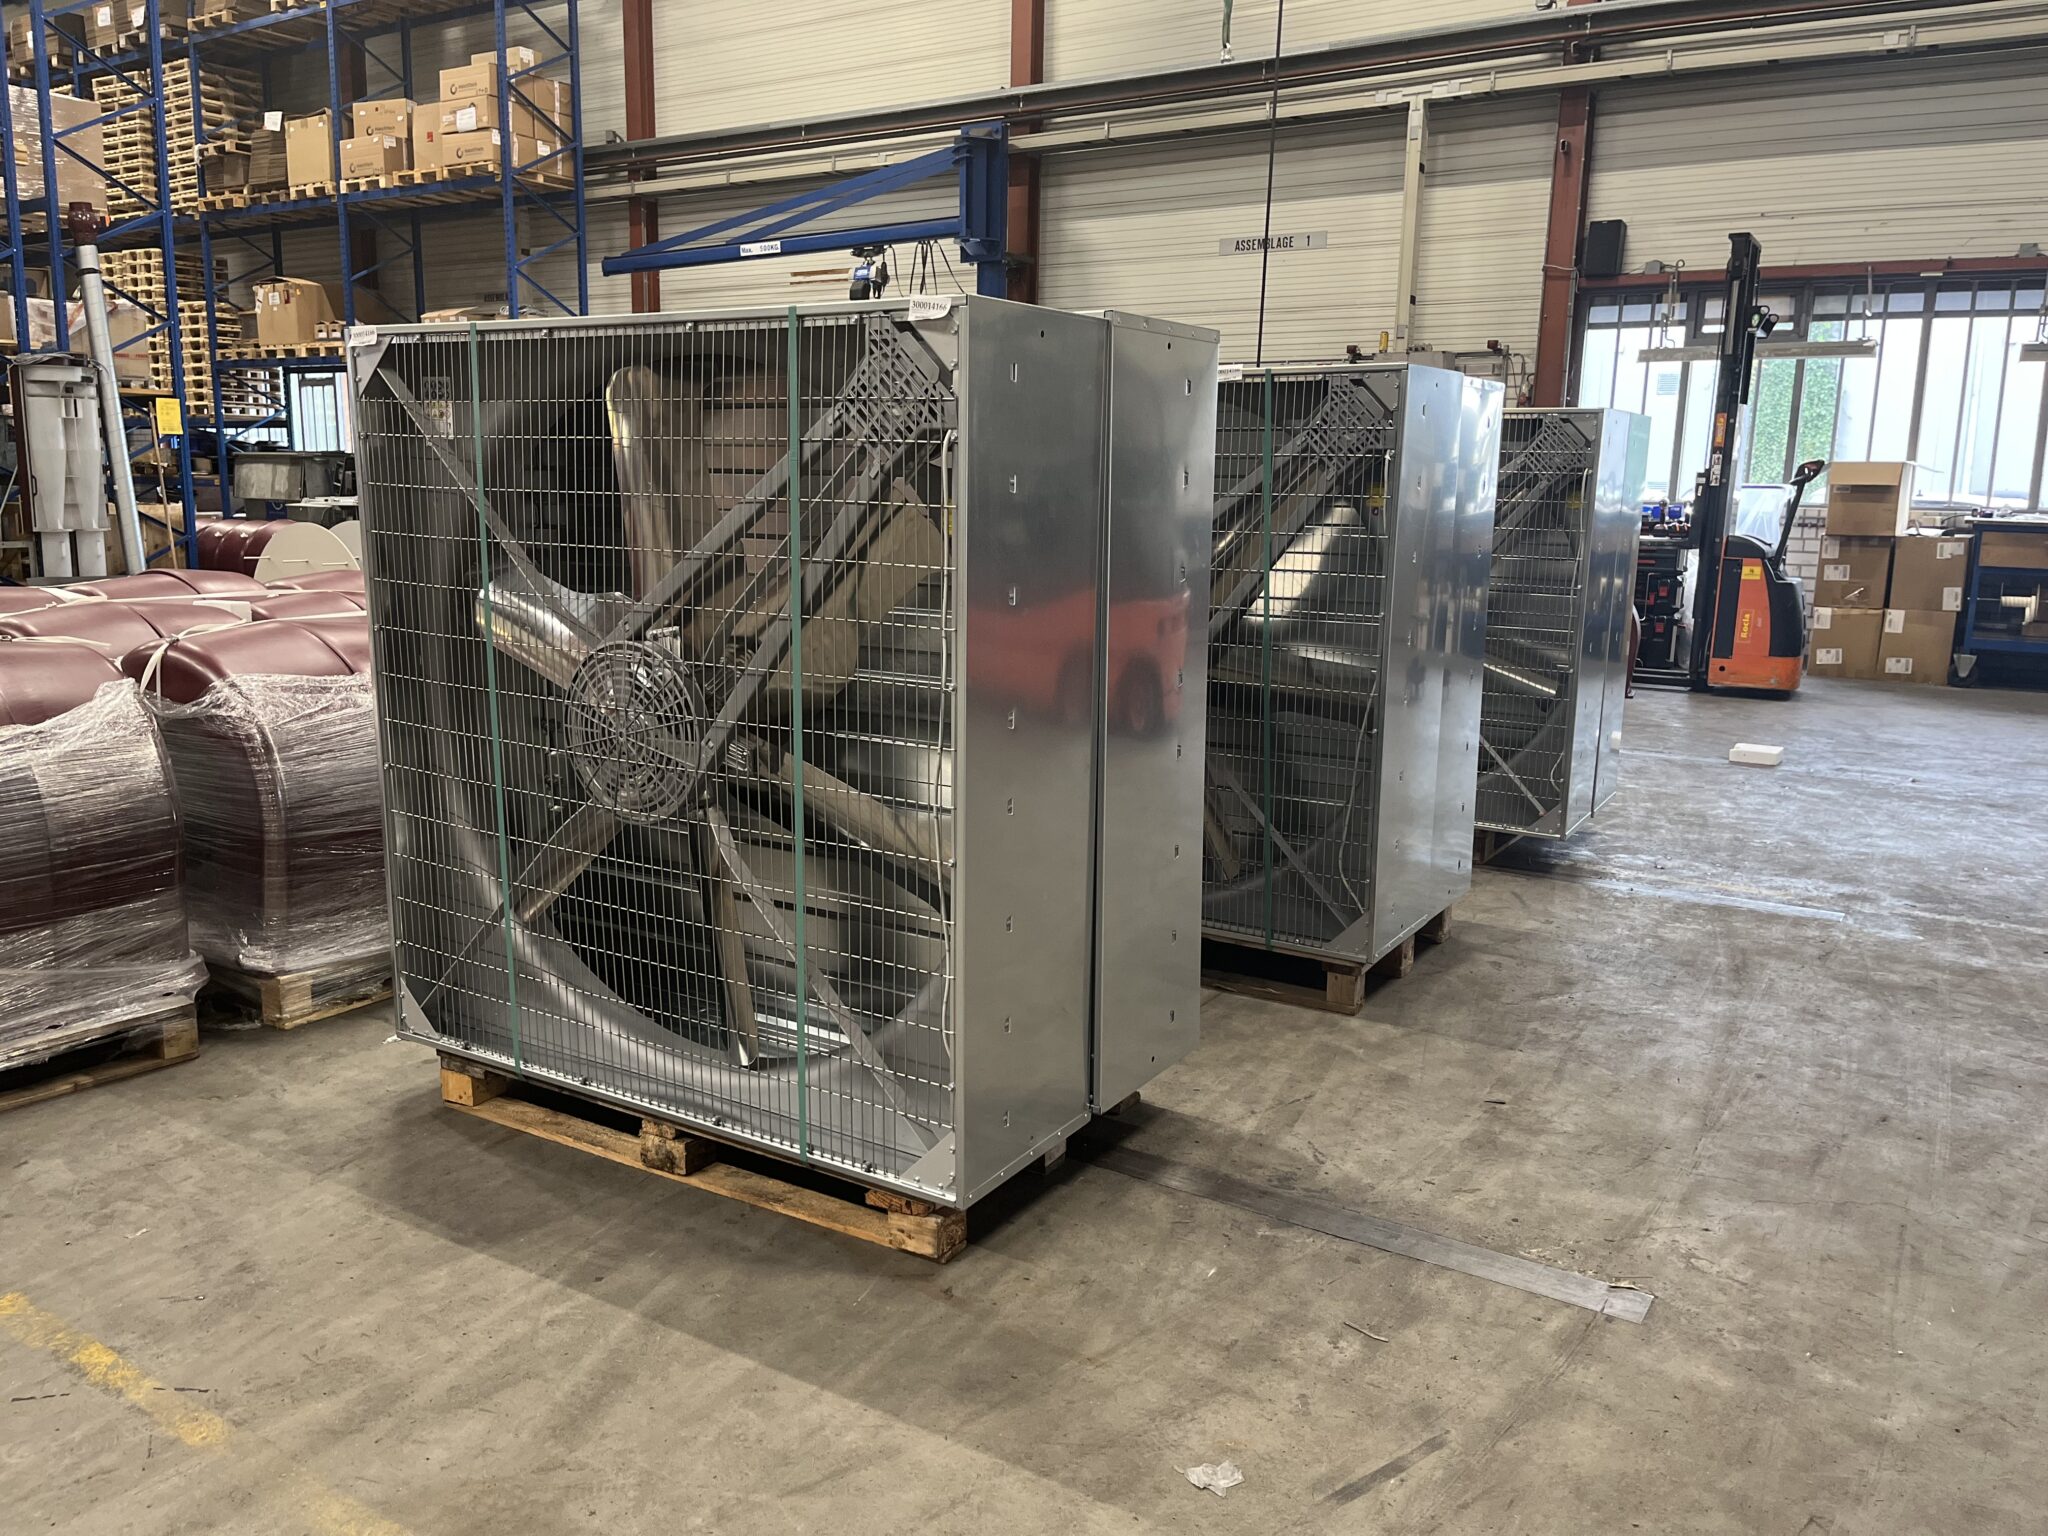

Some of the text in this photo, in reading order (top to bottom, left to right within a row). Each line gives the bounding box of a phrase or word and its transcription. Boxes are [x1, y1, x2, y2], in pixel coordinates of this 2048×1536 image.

[1235, 235, 1311, 252] ASSEMBLAGE 1
[912, 300, 948, 311] 300014166
[1740, 613, 1751, 639] Rocla
